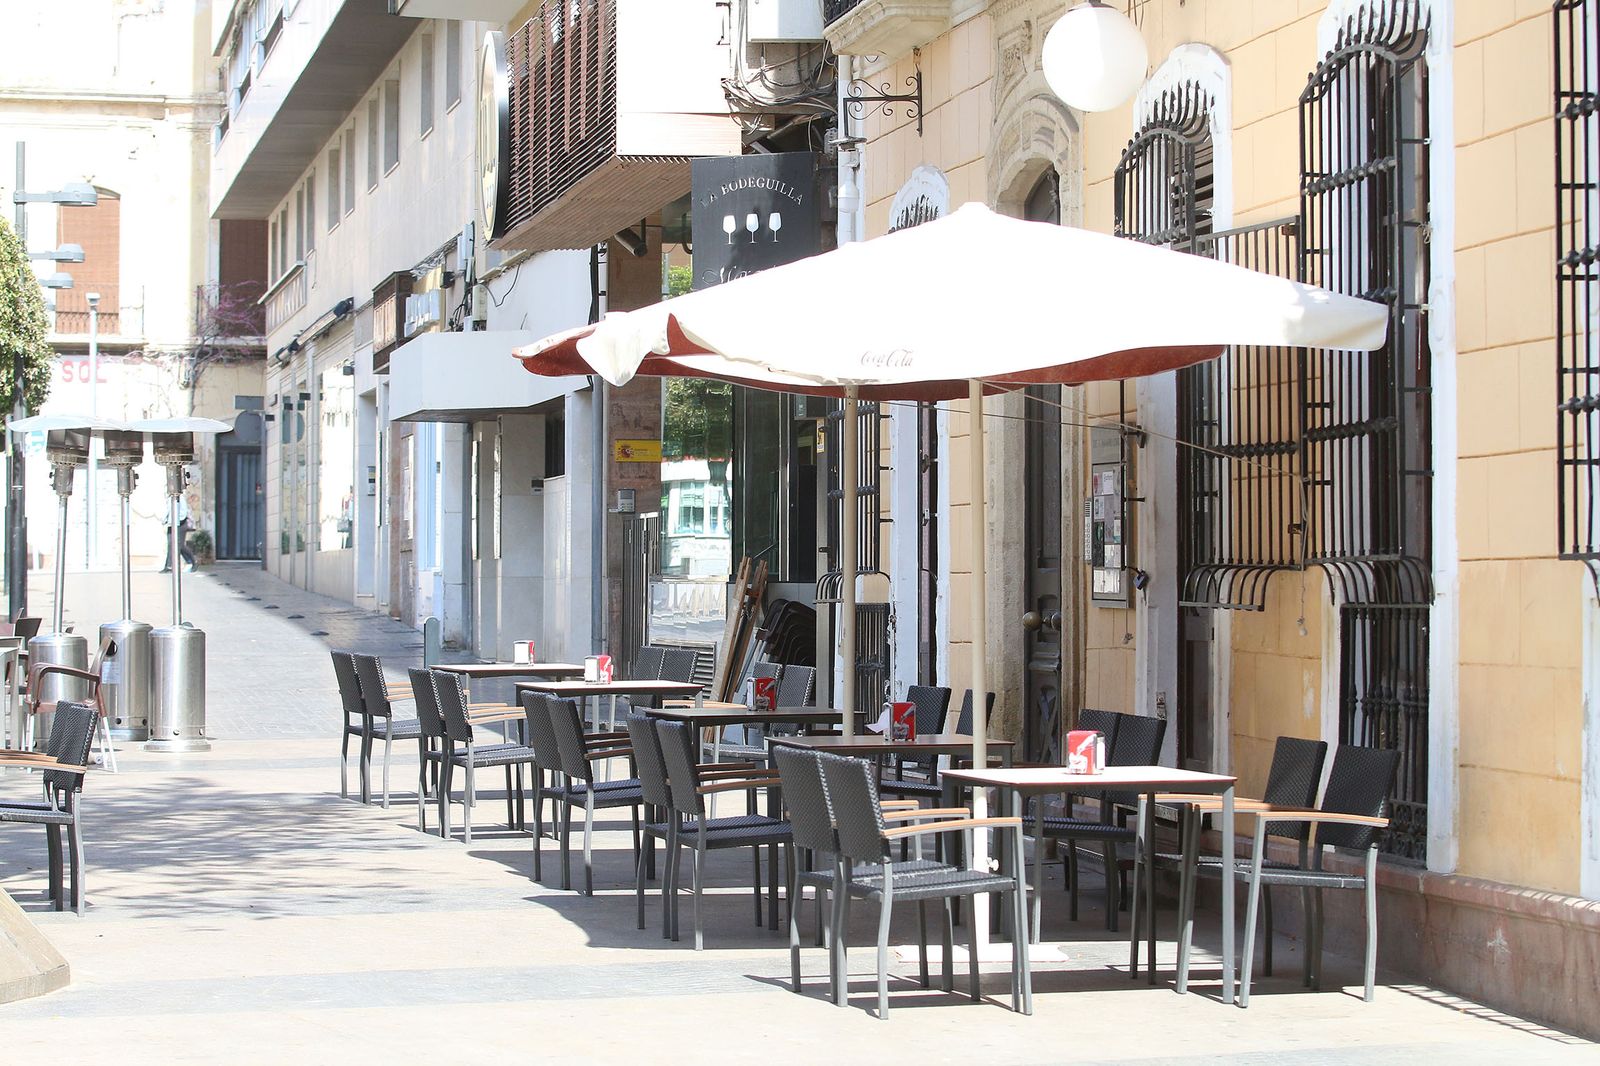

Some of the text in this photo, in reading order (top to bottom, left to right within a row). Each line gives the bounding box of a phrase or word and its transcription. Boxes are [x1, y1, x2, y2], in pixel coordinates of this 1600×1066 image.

[700, 177, 804, 208] LA BODEGUILLA
[63, 360, 107, 383] SOL
